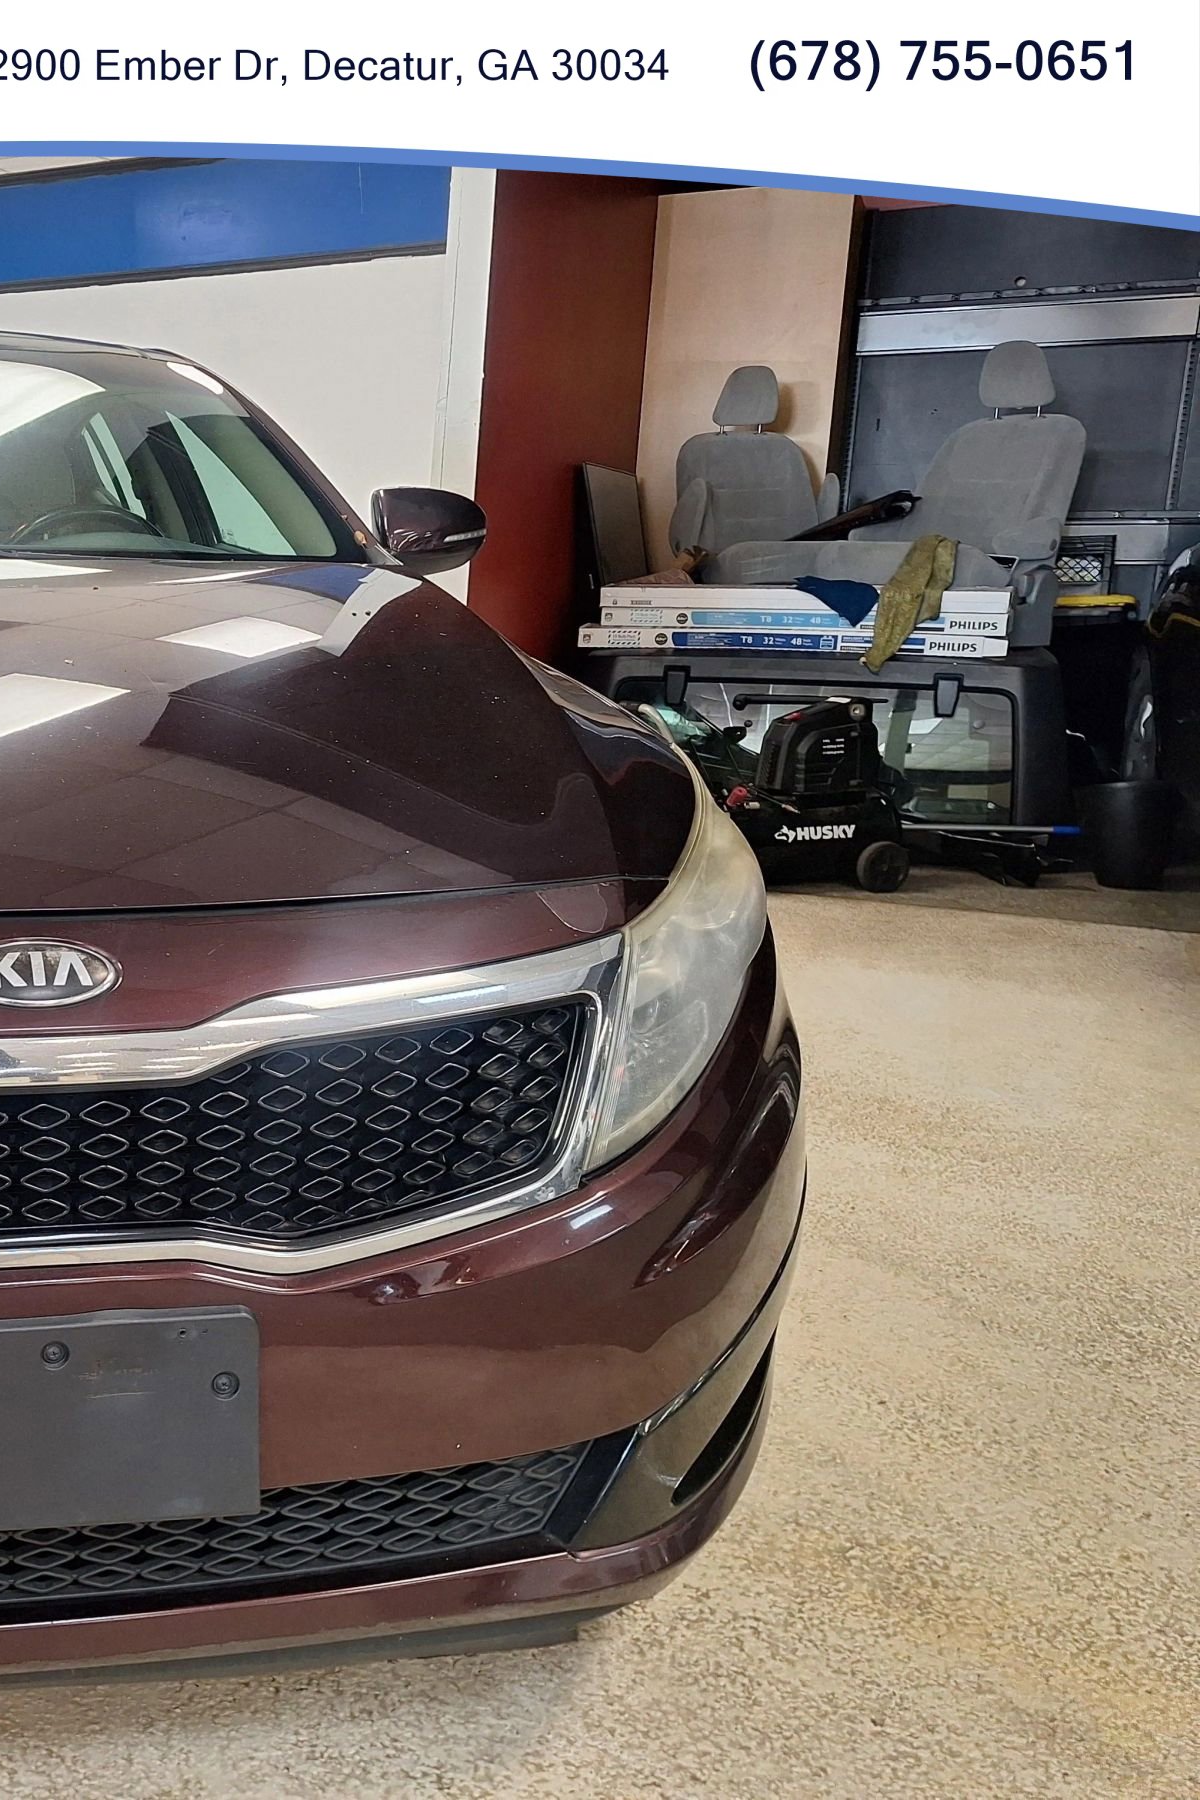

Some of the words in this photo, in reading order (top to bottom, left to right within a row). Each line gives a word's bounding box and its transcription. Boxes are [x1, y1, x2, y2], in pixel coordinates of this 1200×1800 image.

[949, 620, 998, 631] PHILIPS
[740, 636, 753, 644] T8
[762, 636, 774, 645] 32
[790, 637, 802, 646] 48
[928, 641, 978, 653] PHILIPS
[796, 824, 856, 841] HUSKY
